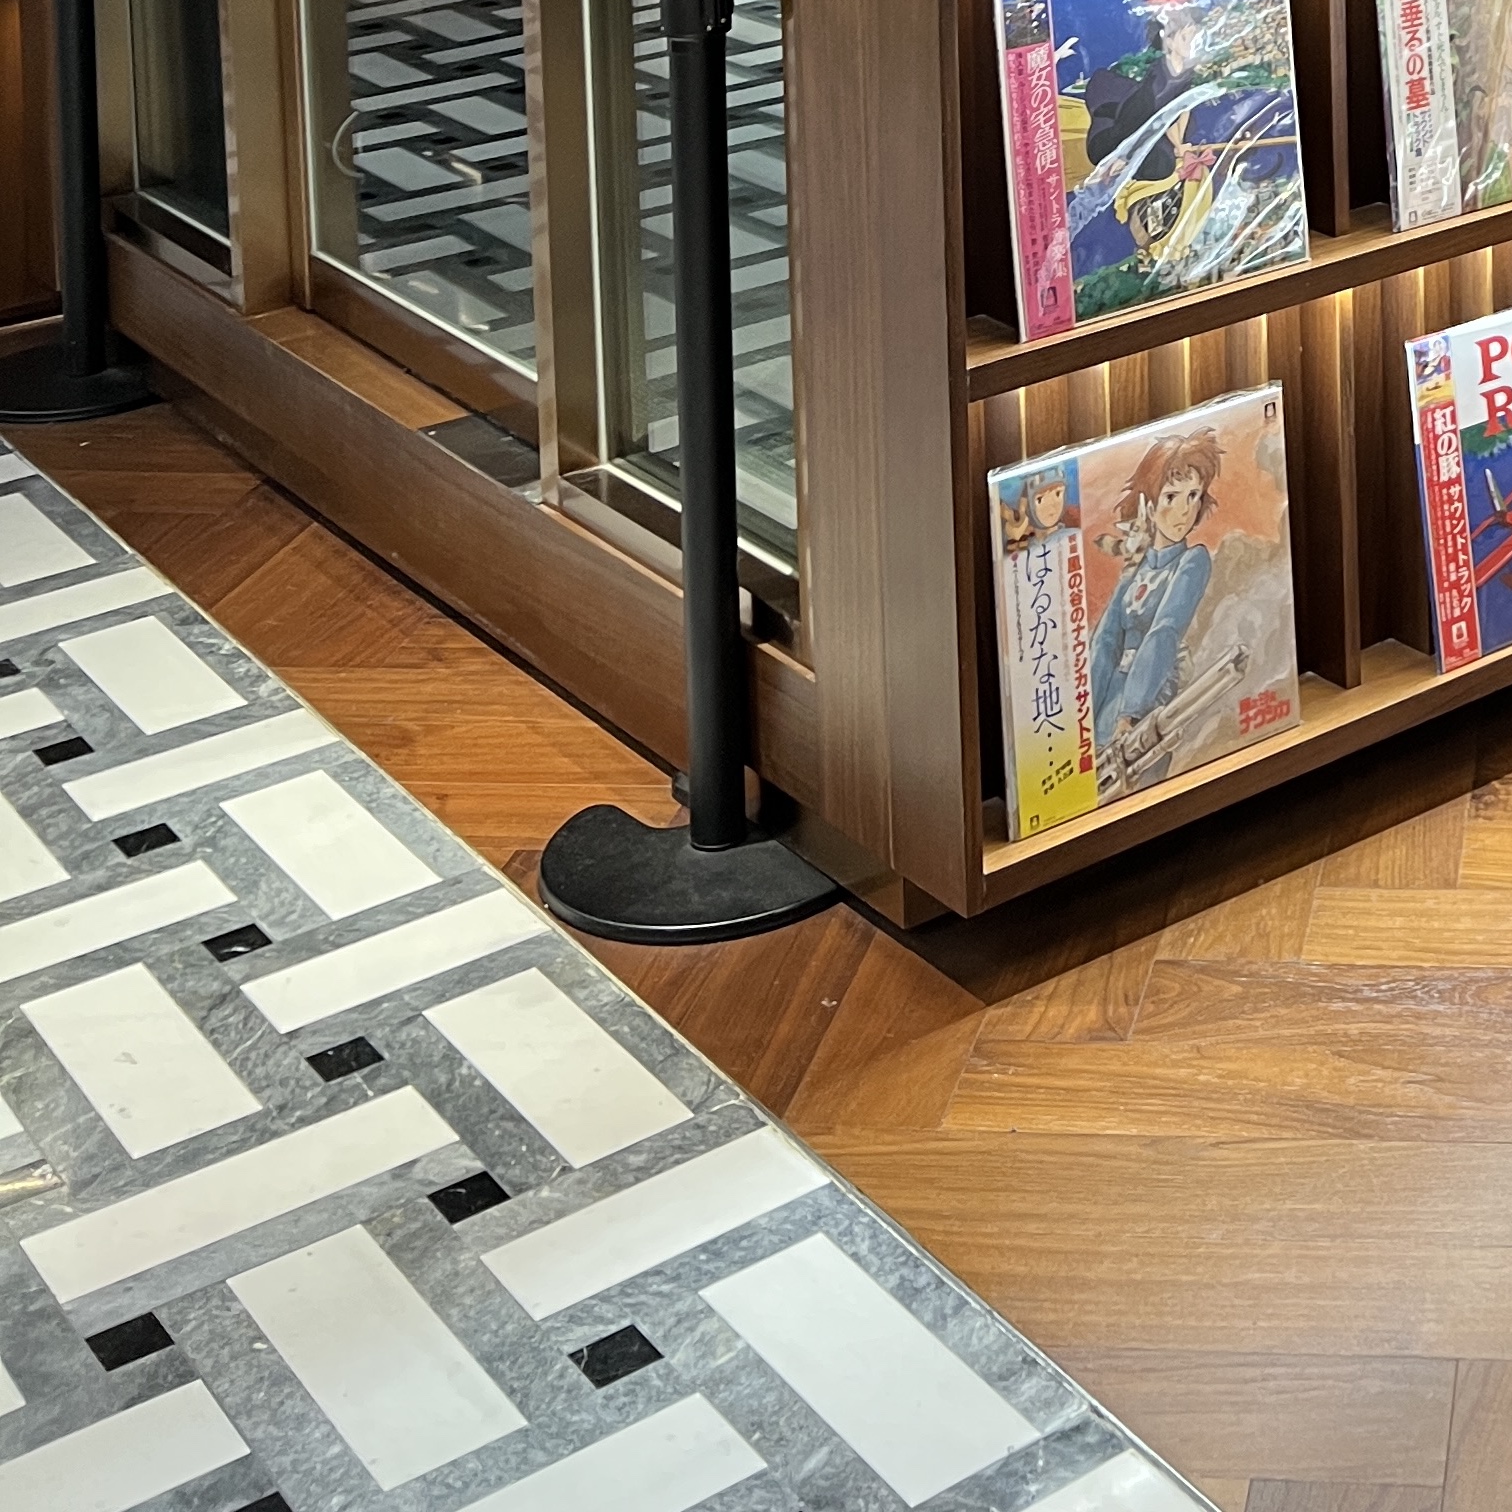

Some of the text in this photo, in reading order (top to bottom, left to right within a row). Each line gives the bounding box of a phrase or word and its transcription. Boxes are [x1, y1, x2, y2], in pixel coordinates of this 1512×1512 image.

[1026, 42, 1059, 176] 魔女の宅急便
[1433, 405, 1461, 483] 紅の豚
[1449, 483, 1473, 614] サウンドトラック
